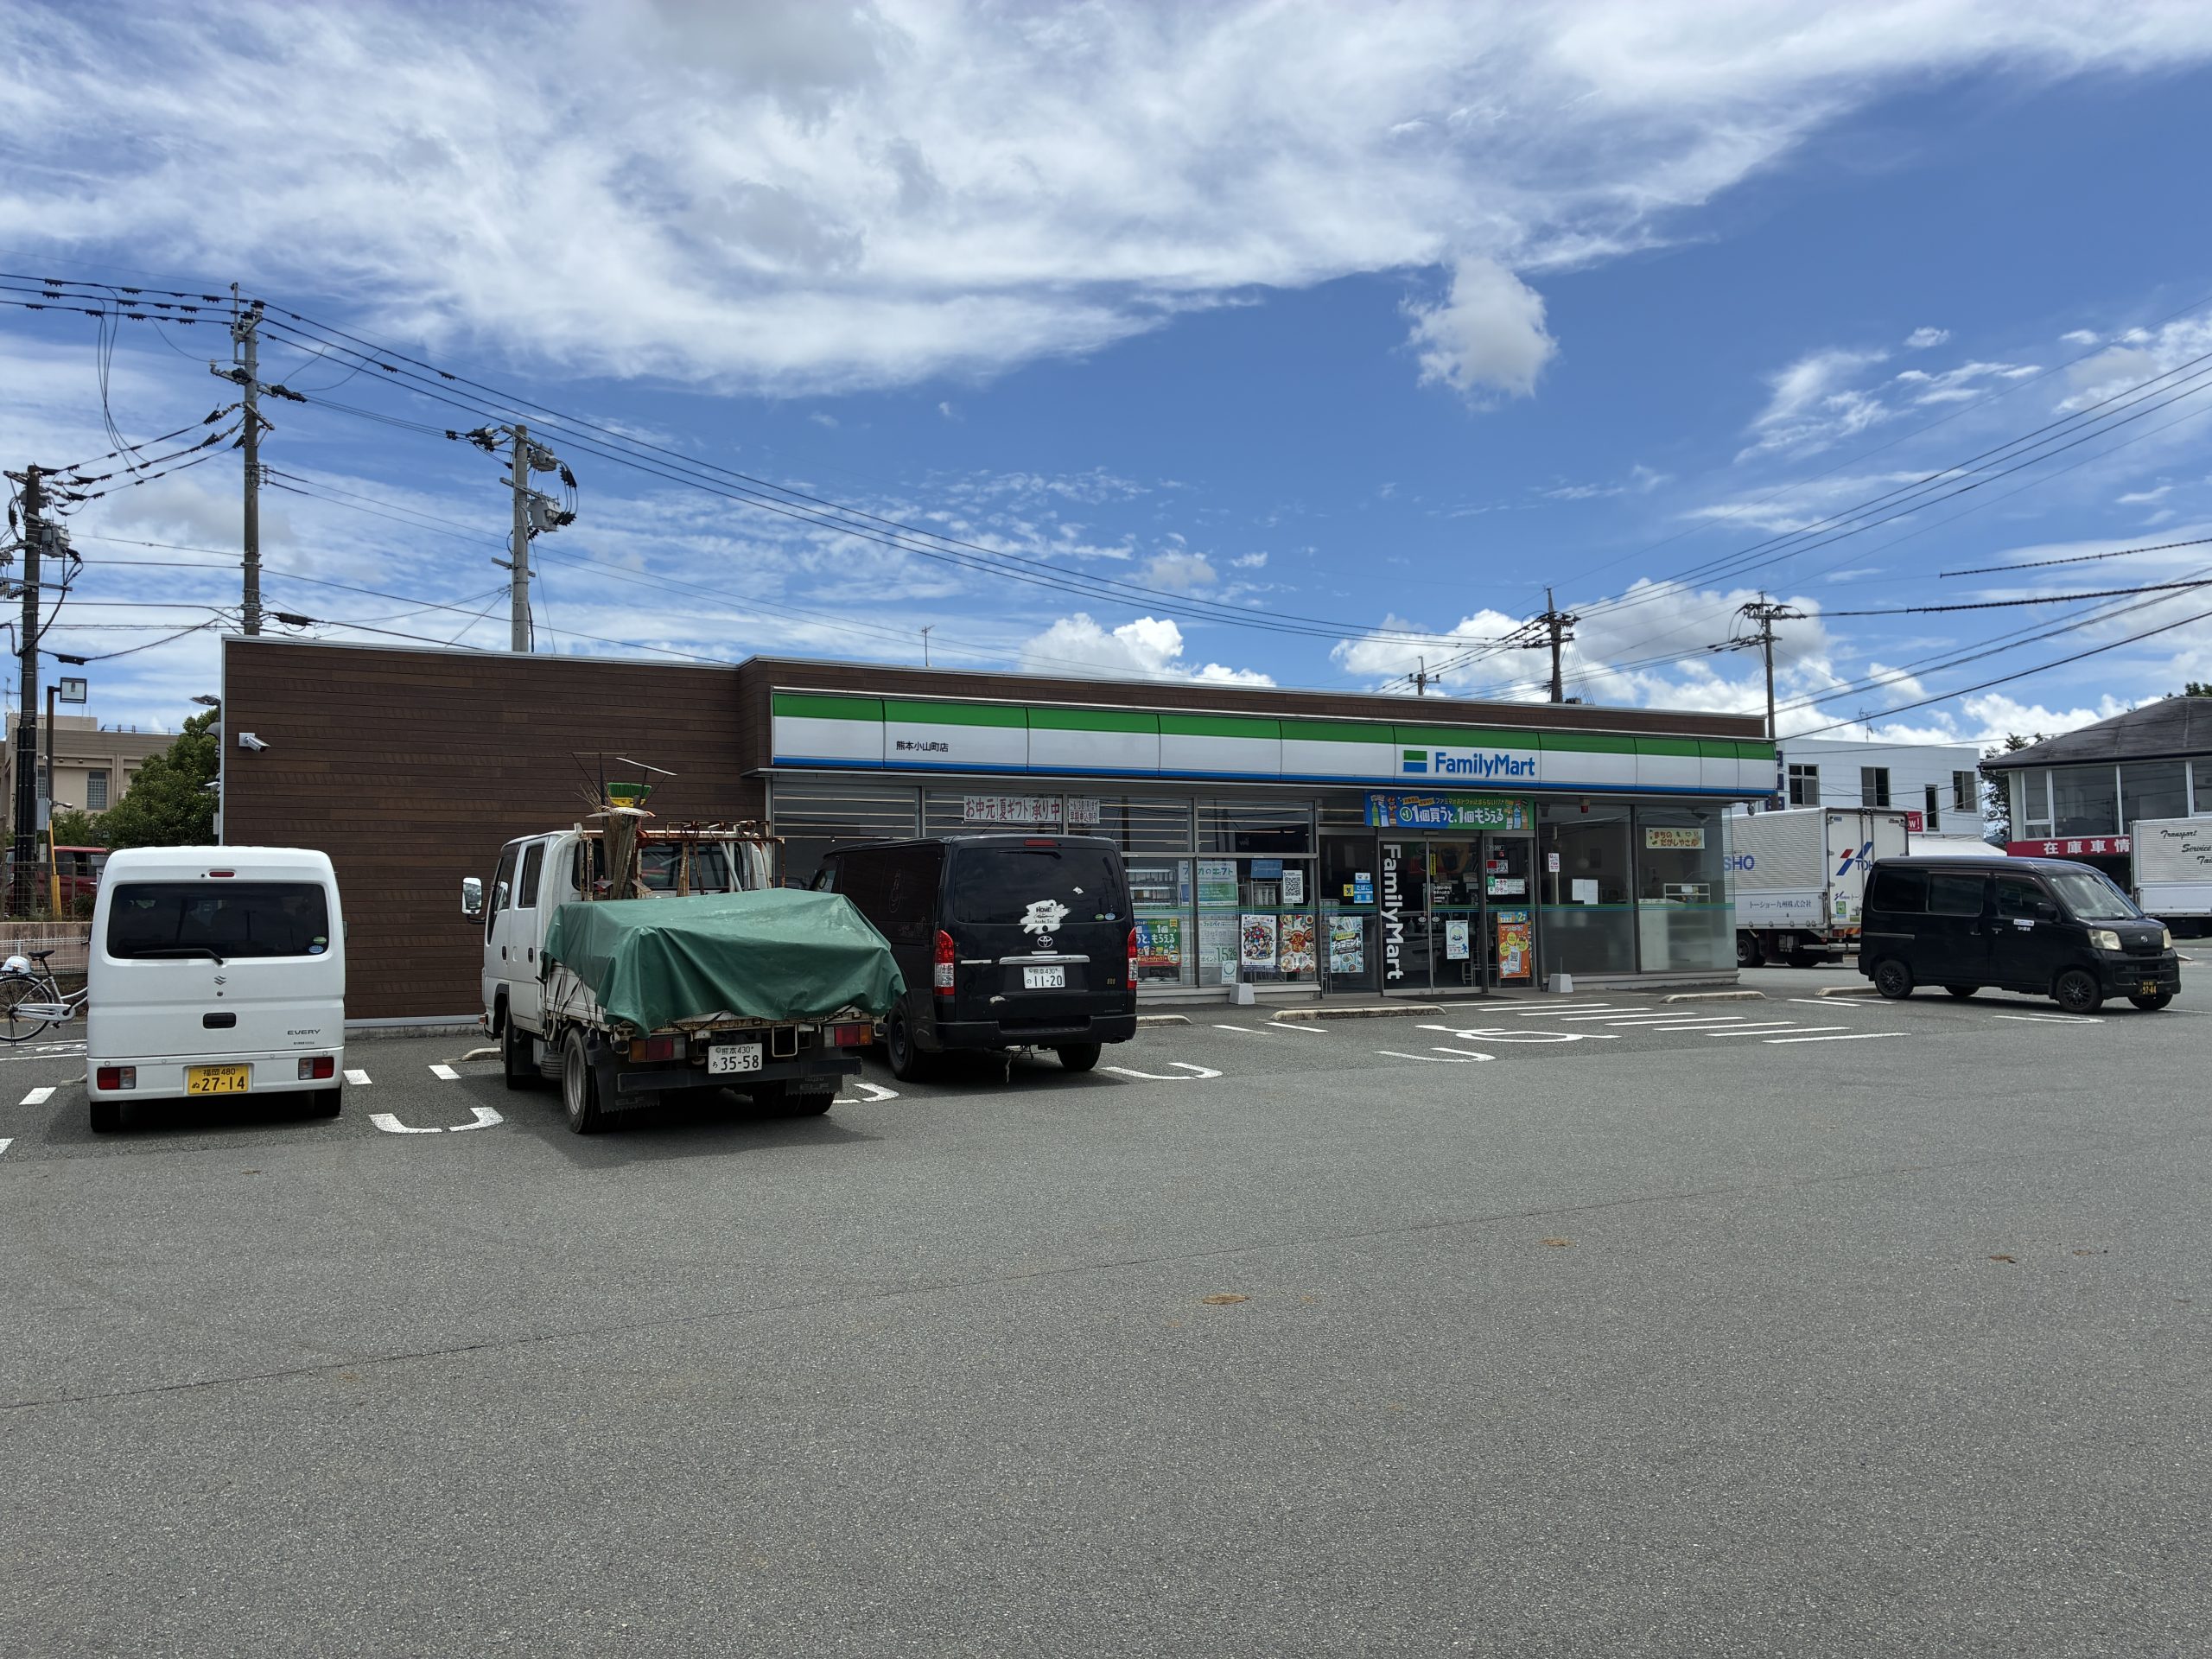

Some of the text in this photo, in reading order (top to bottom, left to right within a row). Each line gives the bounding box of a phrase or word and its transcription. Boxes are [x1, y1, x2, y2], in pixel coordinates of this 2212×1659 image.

[896, 741, 950, 753] 熊本小山町店
[1434, 752, 1535, 778] FamilyMart
[965, 797, 1060, 821] お中元 夏ギフト 承り中
[2160, 830, 2198, 841] Transport
[2044, 839, 2130, 855] 在庫車情
[2181, 843, 2212, 853] Service
[1381, 843, 1404, 980] FamilyMart
[1034, 975, 1063, 987] 11-20
[721, 1054, 760, 1071] 35-58
[201, 1076, 245, 1091] 27-14
